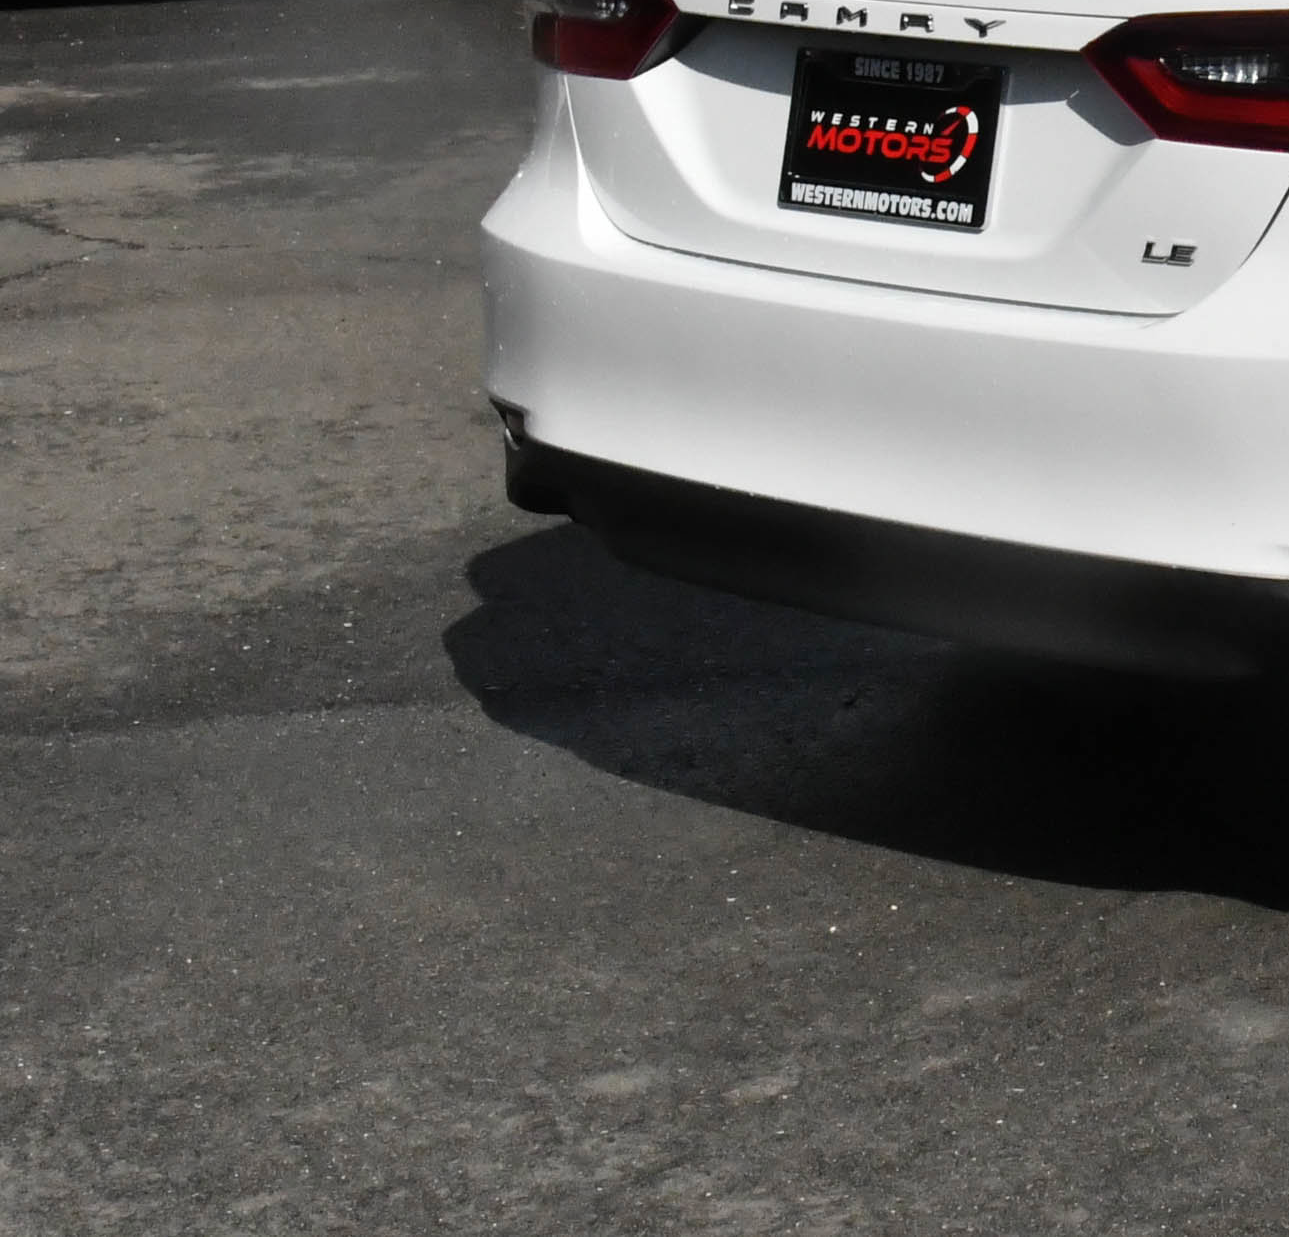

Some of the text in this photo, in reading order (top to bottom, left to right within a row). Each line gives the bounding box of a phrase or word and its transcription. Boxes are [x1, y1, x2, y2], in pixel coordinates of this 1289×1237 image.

[855, 57, 945, 84] SINCE 1987
[810, 110, 934, 136] WESTERN
[807, 124, 953, 164] MOTORS
[791, 181, 974, 224] WESTERNMOTORS.COM
[1141, 241, 1197, 266] LE
